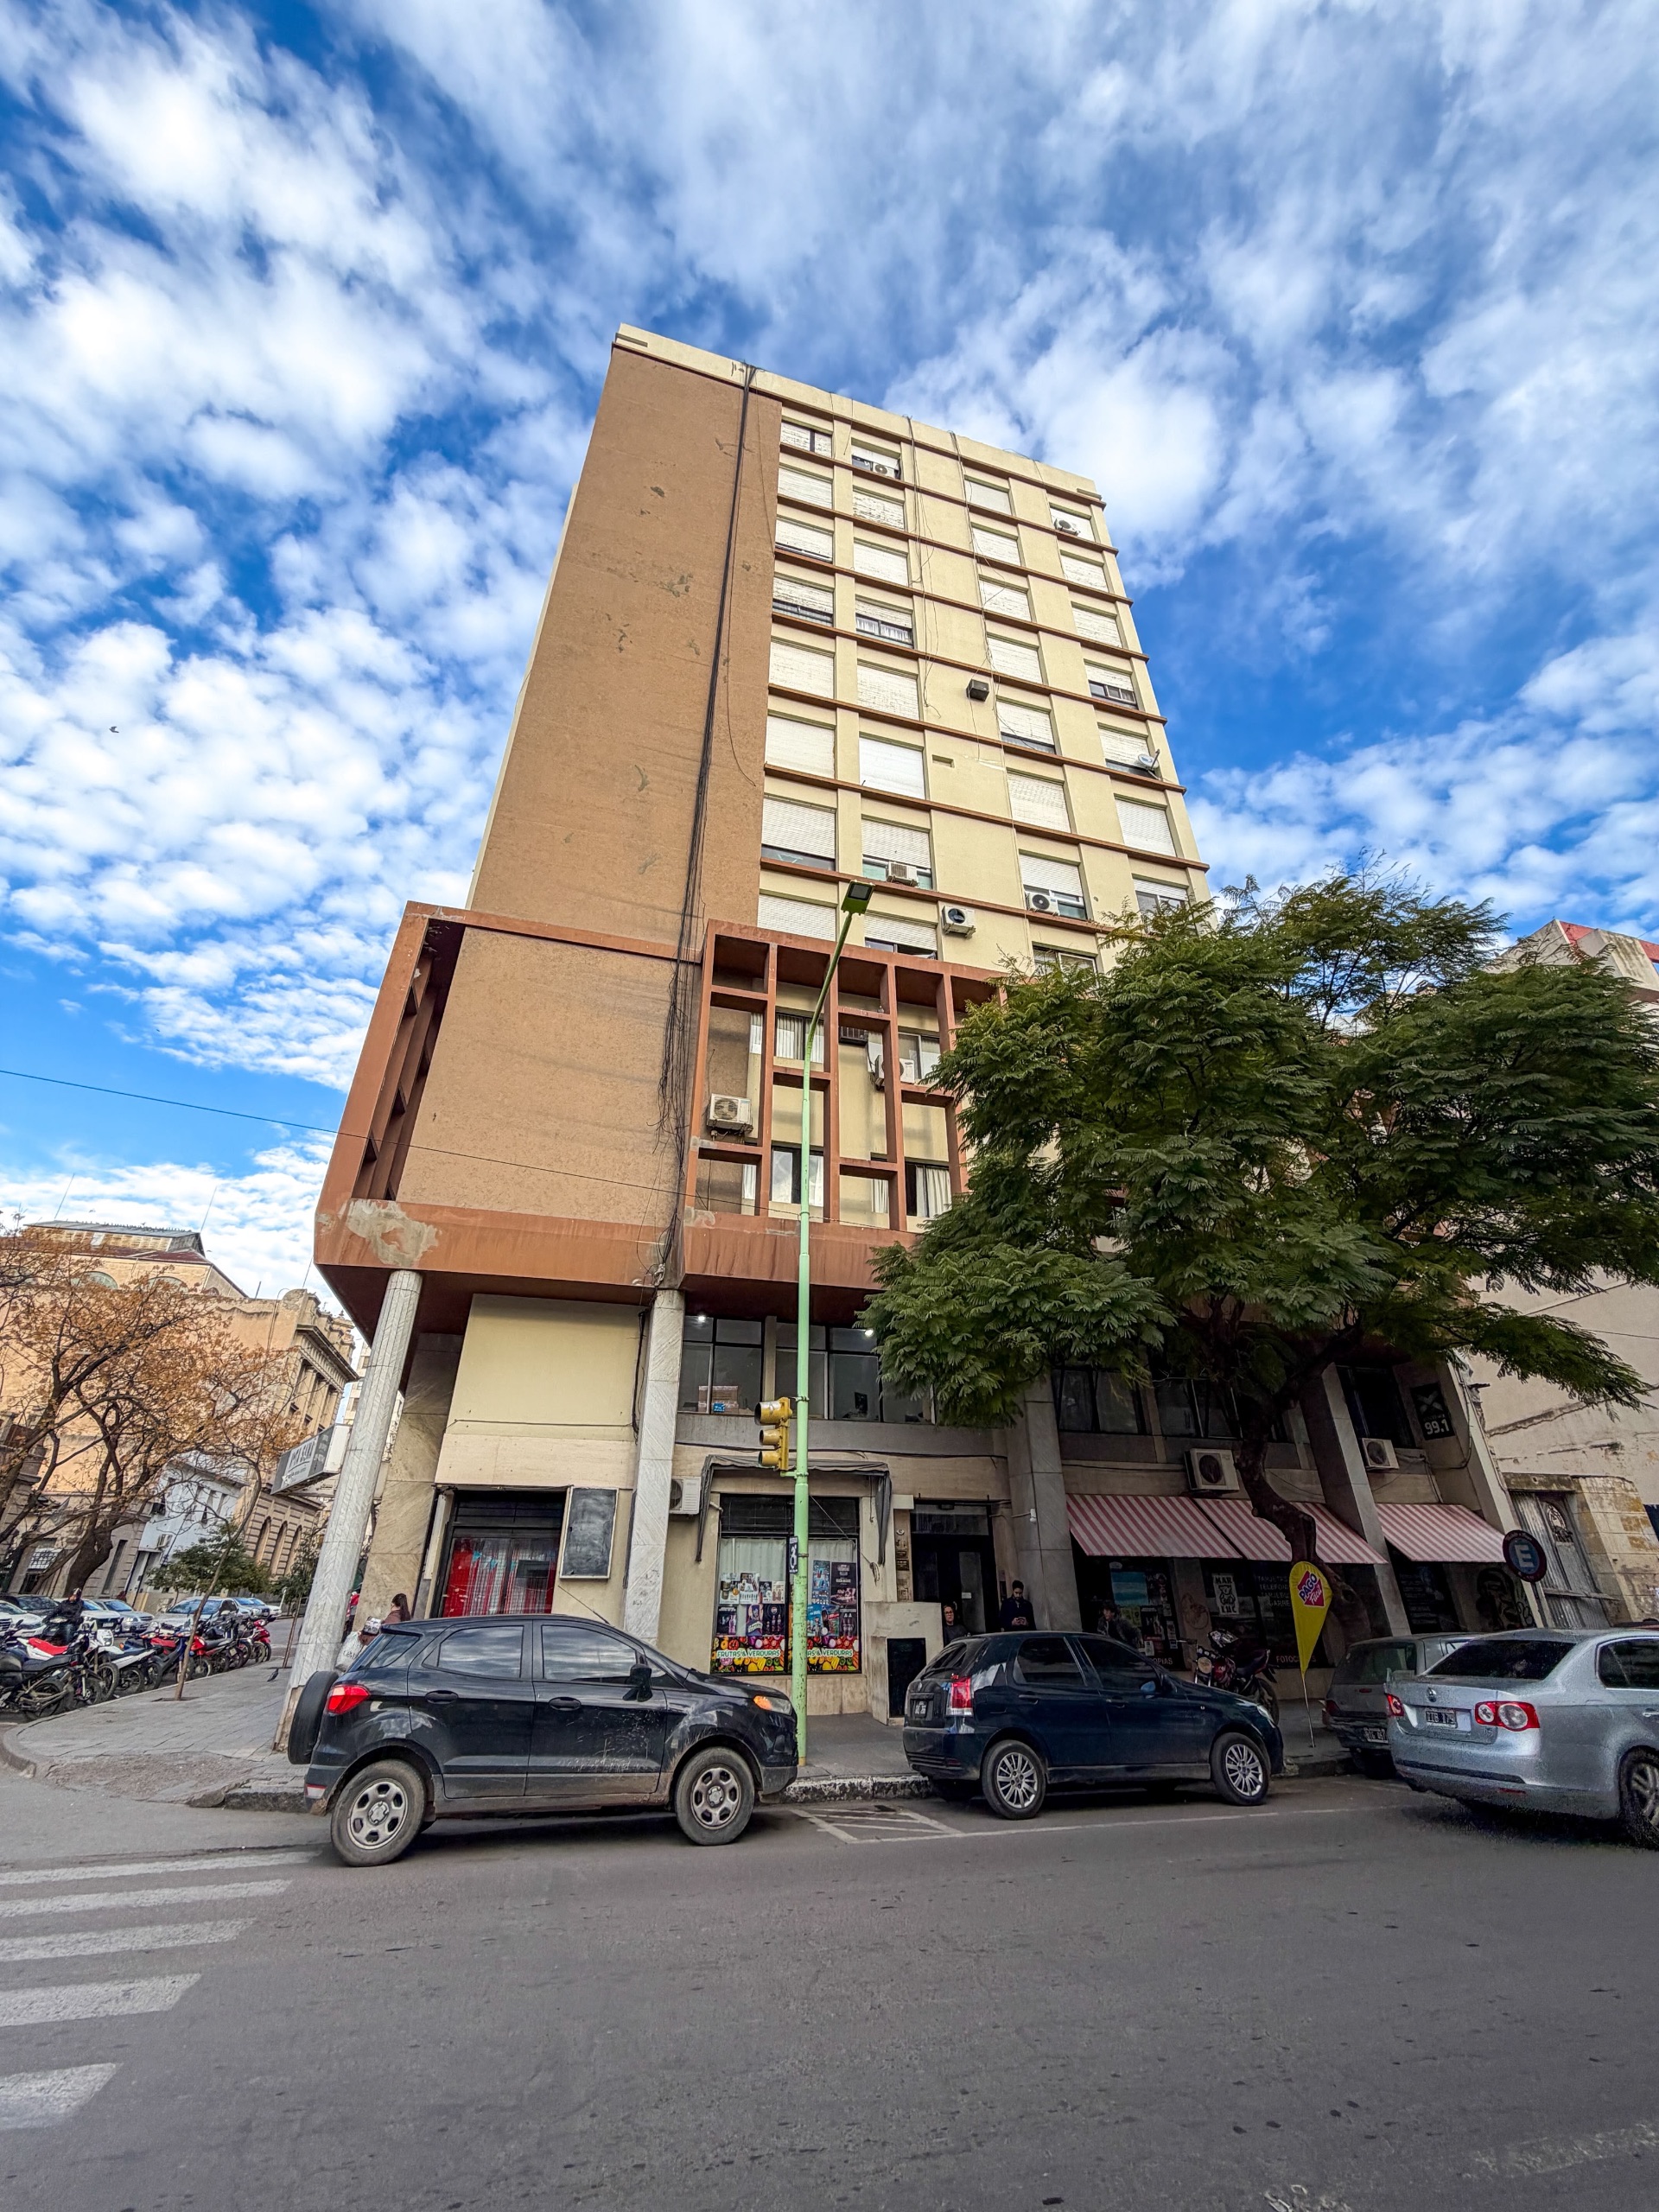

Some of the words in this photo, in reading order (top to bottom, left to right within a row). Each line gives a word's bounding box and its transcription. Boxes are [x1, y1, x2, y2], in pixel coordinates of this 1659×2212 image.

[1424, 1419, 1450, 1435] 99.1
[1514, 1544, 1535, 1568] E
[1299, 1573, 1318, 1602] PAGO
